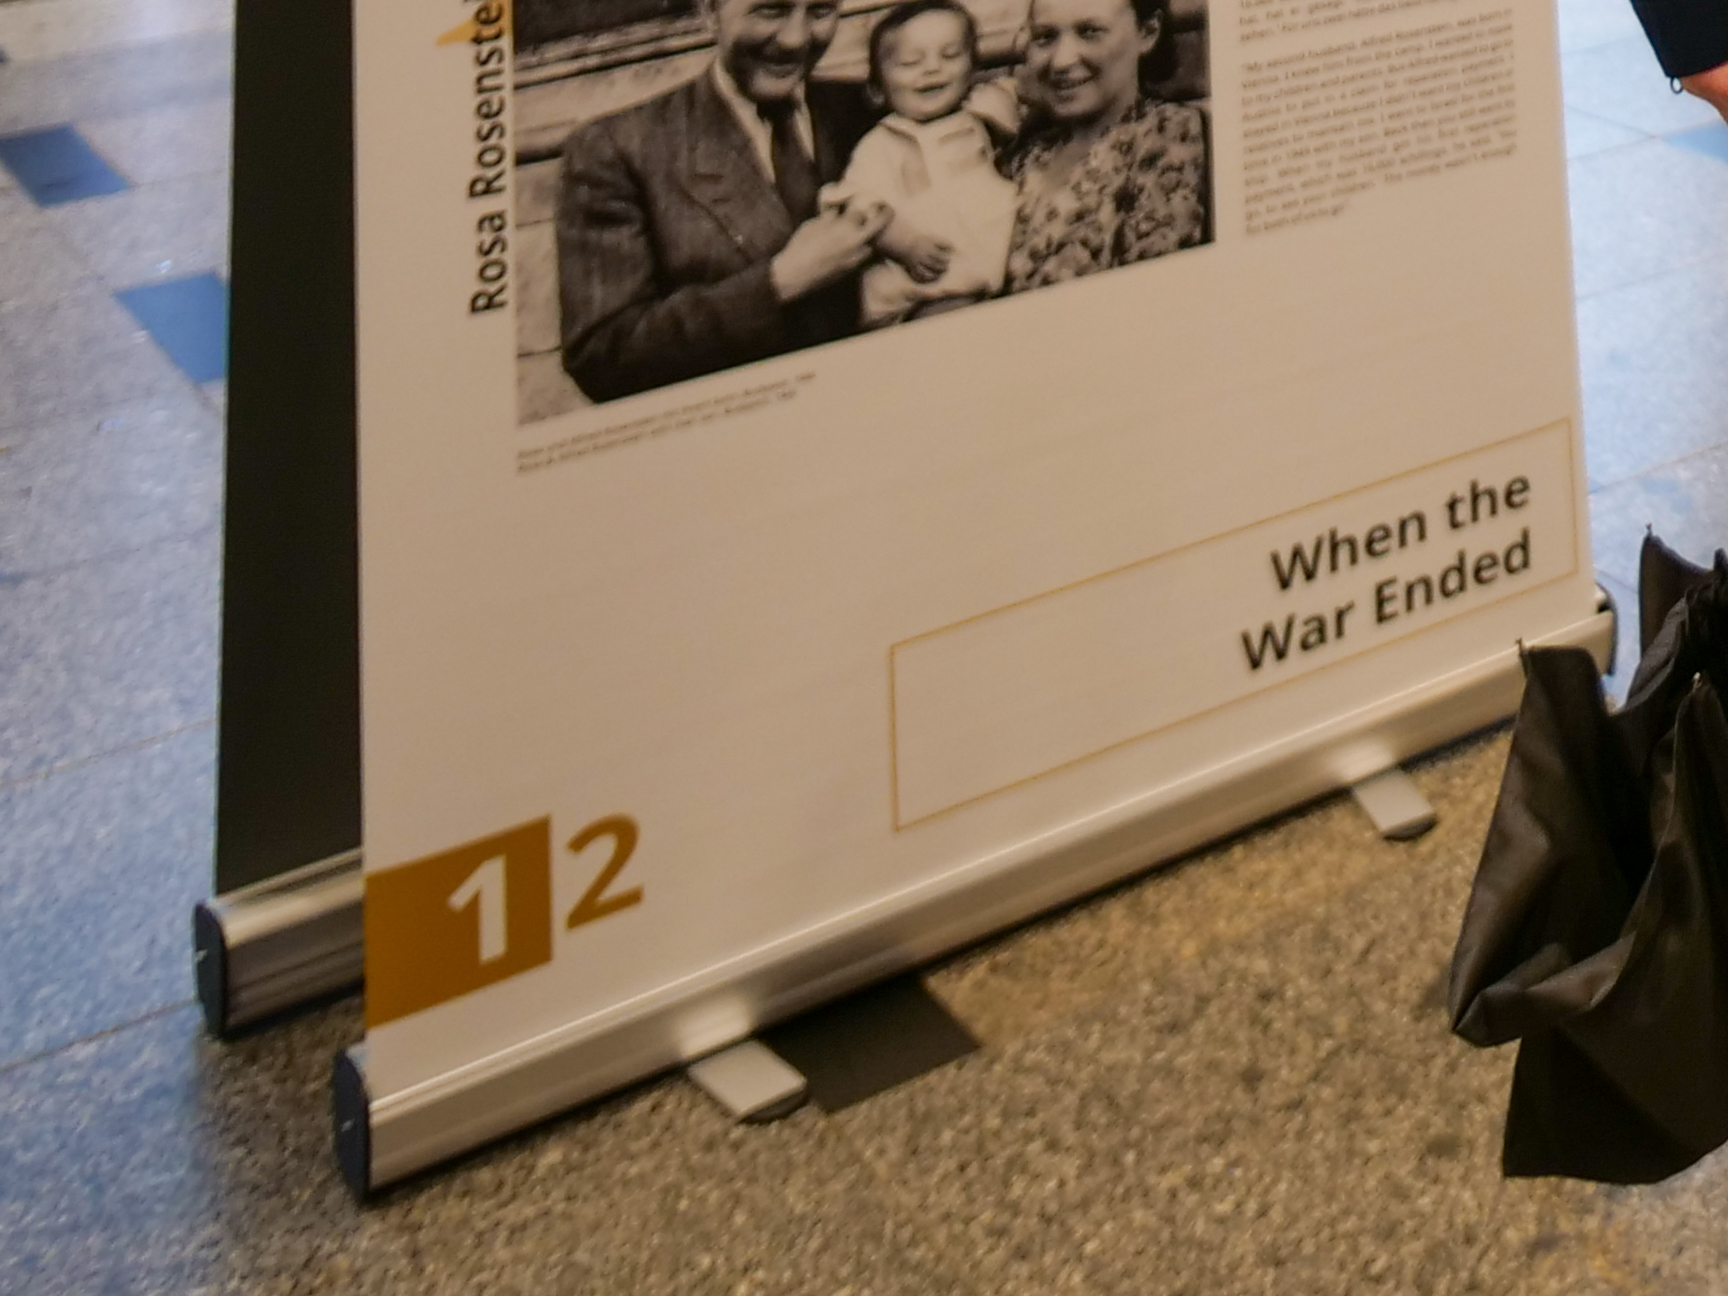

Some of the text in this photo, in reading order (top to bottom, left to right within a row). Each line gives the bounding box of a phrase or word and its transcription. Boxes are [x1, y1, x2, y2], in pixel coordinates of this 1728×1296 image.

[469, 210, 508, 314] Rosa
[1270, 475, 1531, 592] When the
[1240, 525, 1531, 671] War Ended
